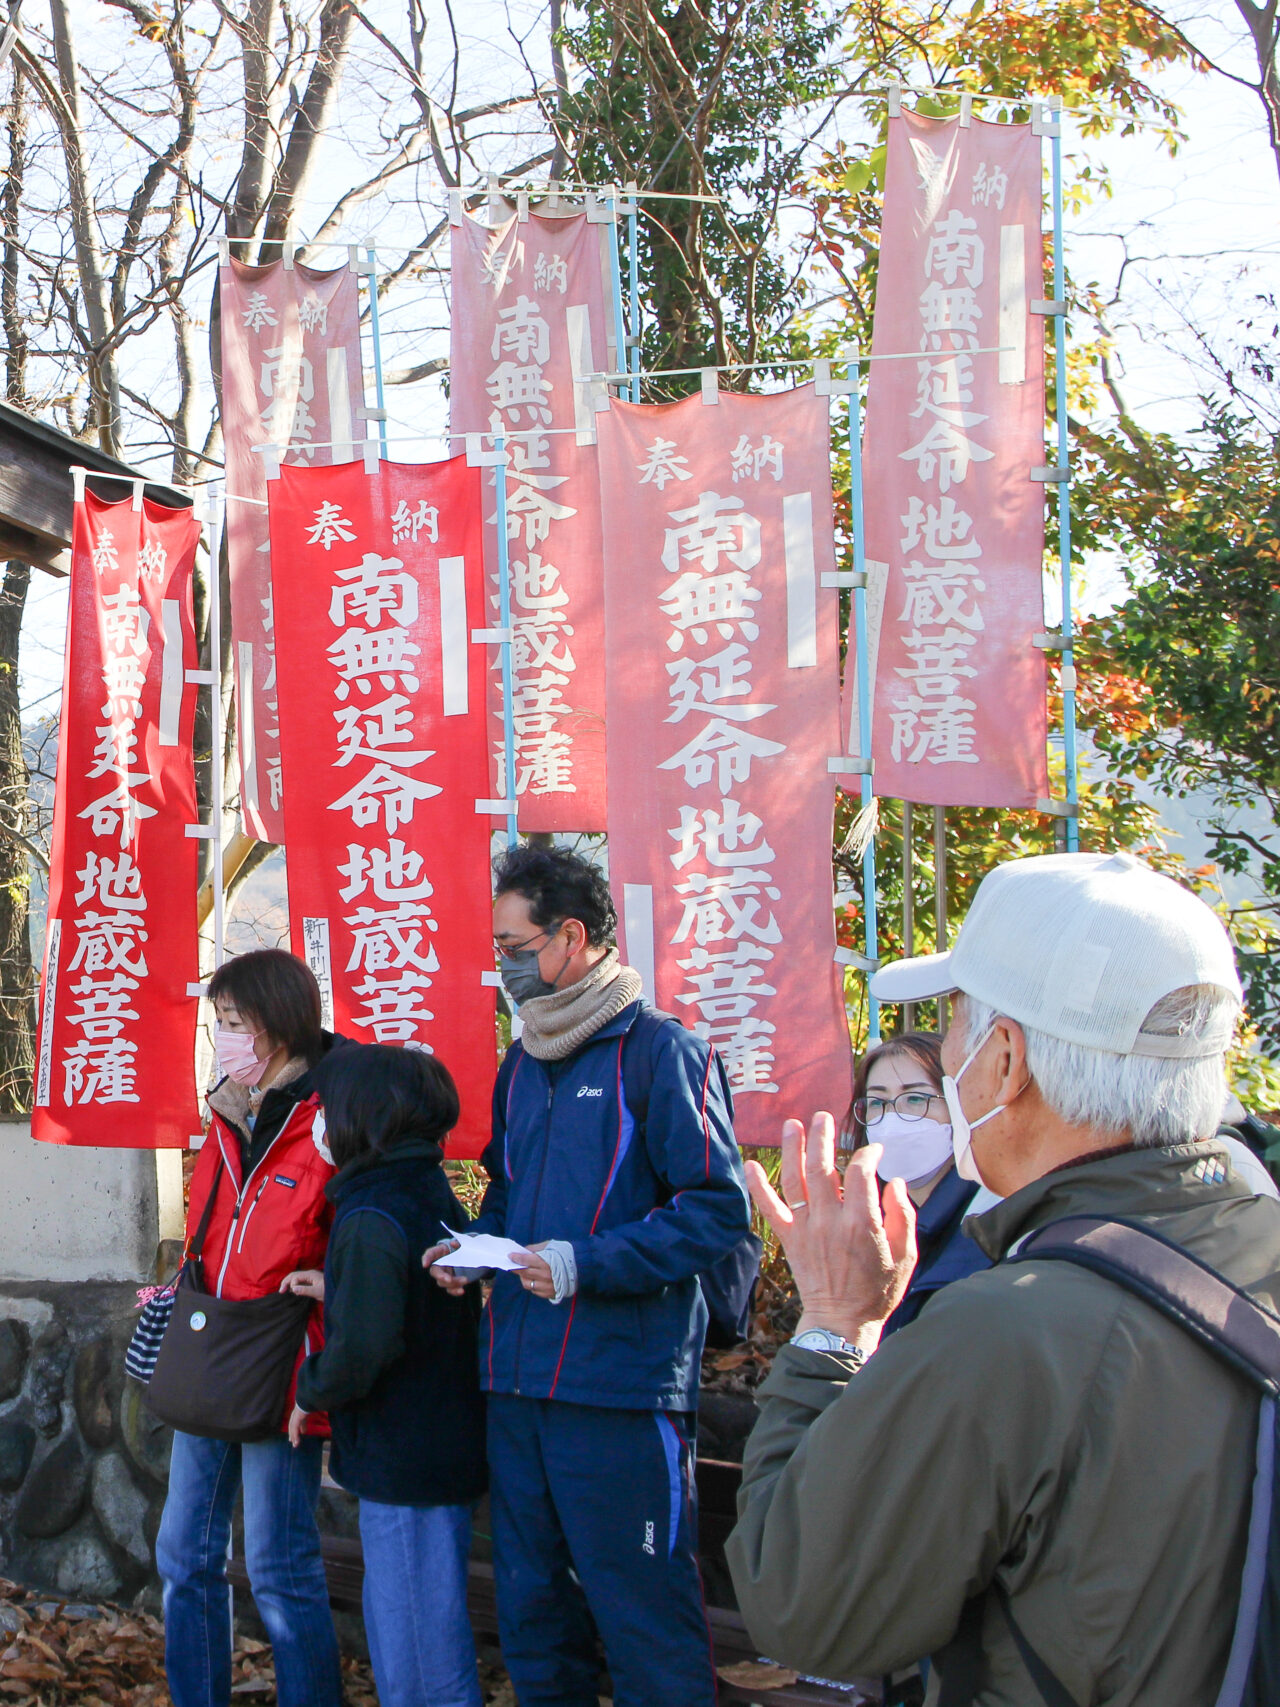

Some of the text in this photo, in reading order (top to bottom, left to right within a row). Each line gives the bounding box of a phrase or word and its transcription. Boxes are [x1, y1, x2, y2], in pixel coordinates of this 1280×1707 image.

[92, 527, 167, 585] 奉納
[240, 291, 329, 337] 奉納
[305, 500, 439, 551] 奉納
[485, 296, 577, 794] 南無延命地蔵菩薩
[637, 433, 783, 490] 奉納
[891, 209, 994, 764] 南無延命地蔵菩薩
[63, 582, 158, 1105] 南無延命地蔵菩薩
[326, 552, 444, 1055] 南無延命地蔵菩
[657, 490, 786, 1095] 南無延命地蔵菩薩
